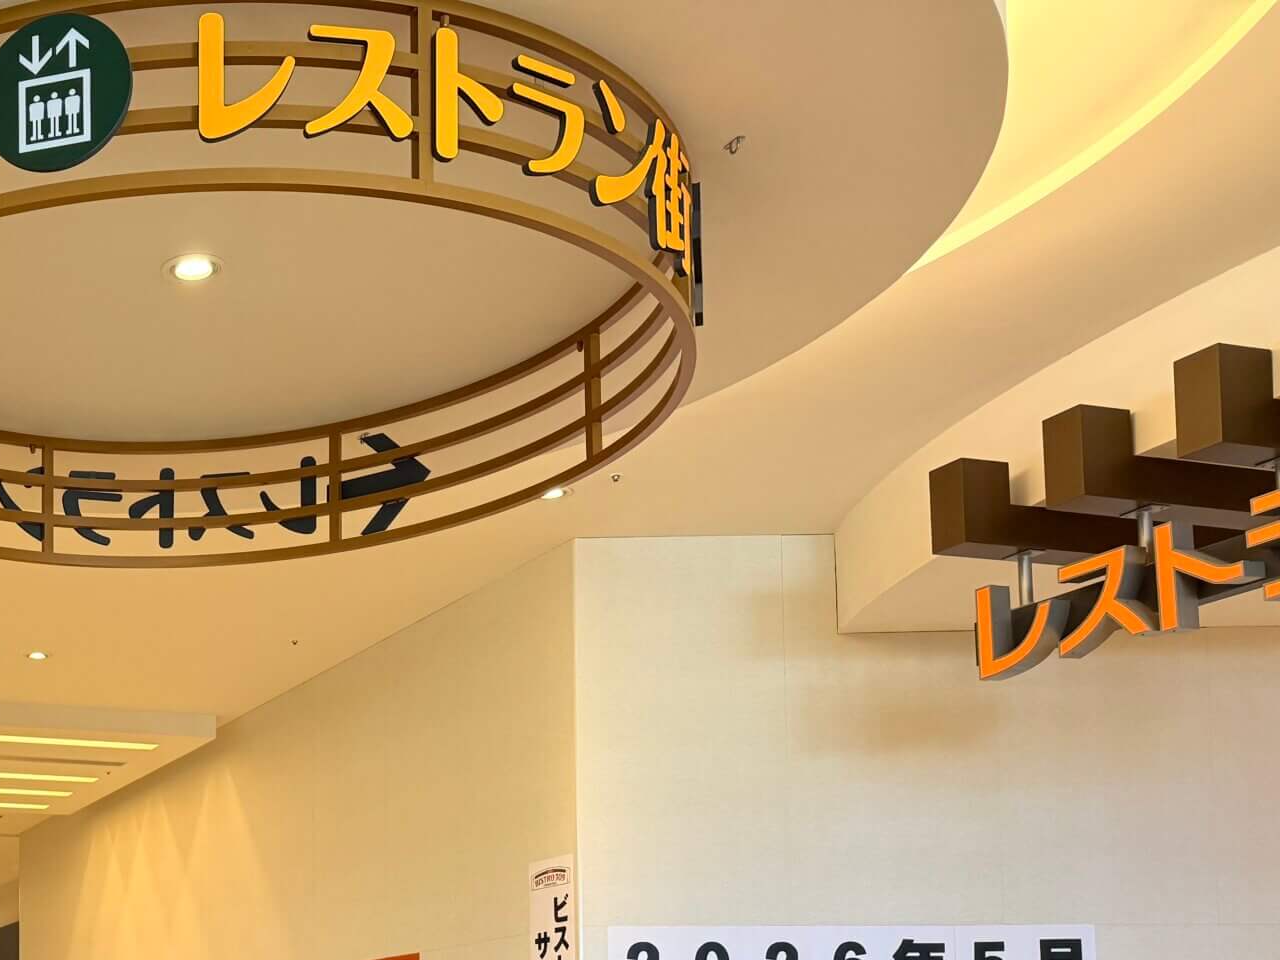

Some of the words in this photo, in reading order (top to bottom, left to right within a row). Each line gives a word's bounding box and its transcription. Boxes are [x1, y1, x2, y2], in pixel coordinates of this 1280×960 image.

[197, 12, 691, 276] レストラン街
[976, 489, 1280, 680] レスト
